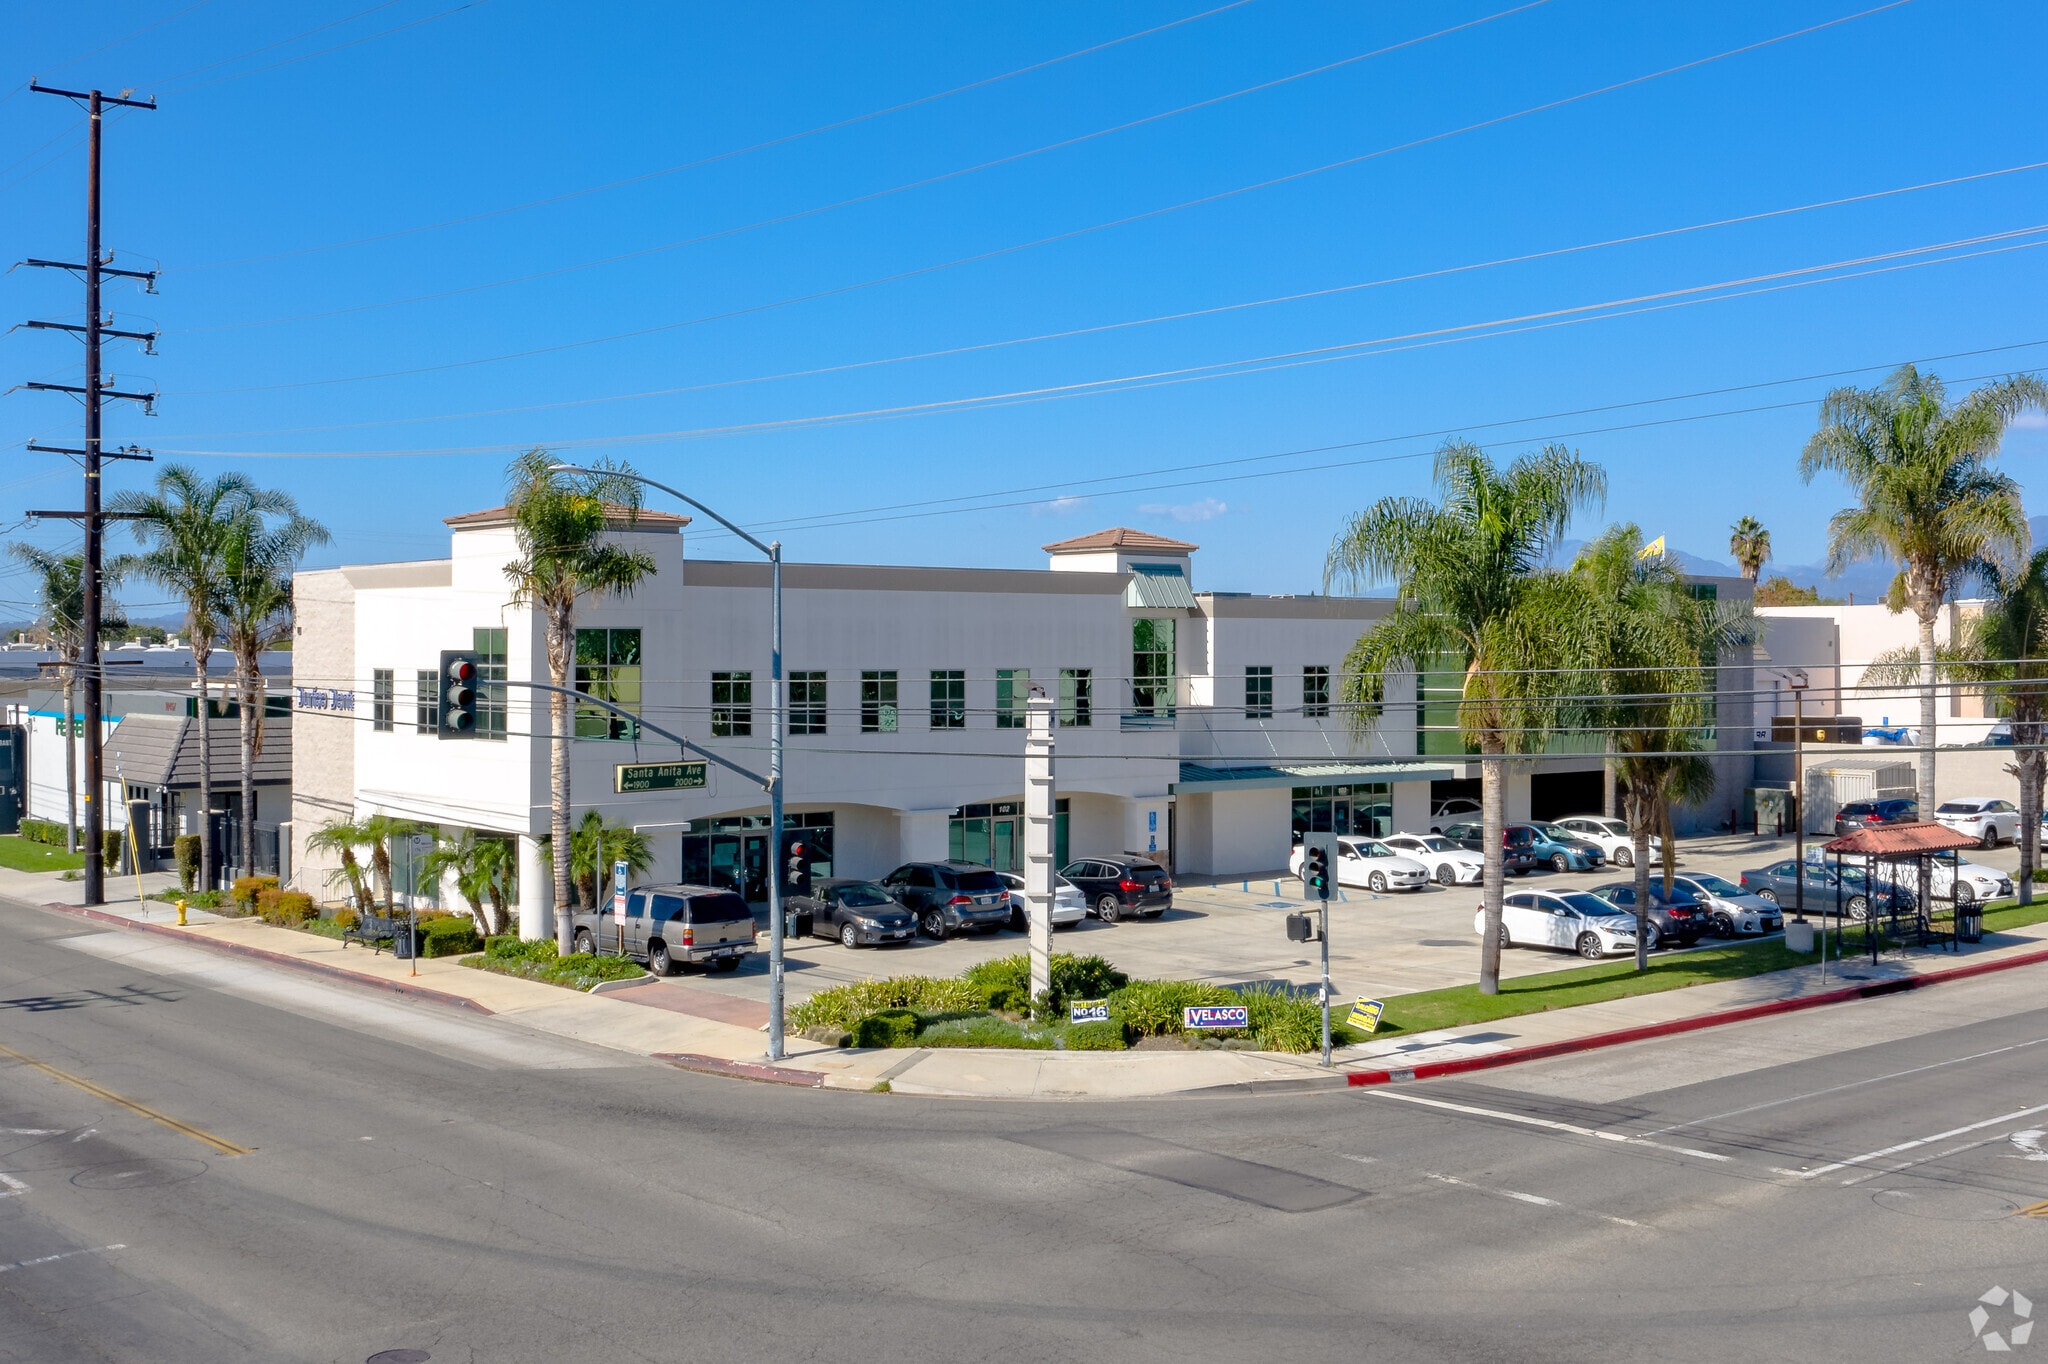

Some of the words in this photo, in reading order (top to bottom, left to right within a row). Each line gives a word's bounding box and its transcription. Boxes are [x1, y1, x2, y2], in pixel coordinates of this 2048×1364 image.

[297, 687, 327, 709] Durfee
[627, 768, 654, 779] Santa
[657, 765, 682, 777] Anita
[686, 765, 702, 775] Ave
[633, 780, 650, 789] 1900
[674, 778, 694, 787] 2000
[1073, 1007, 1088, 1017] NO
[1089, 1006, 1106, 1018] 16
[1190, 1009, 1245, 1025] VELASCO
